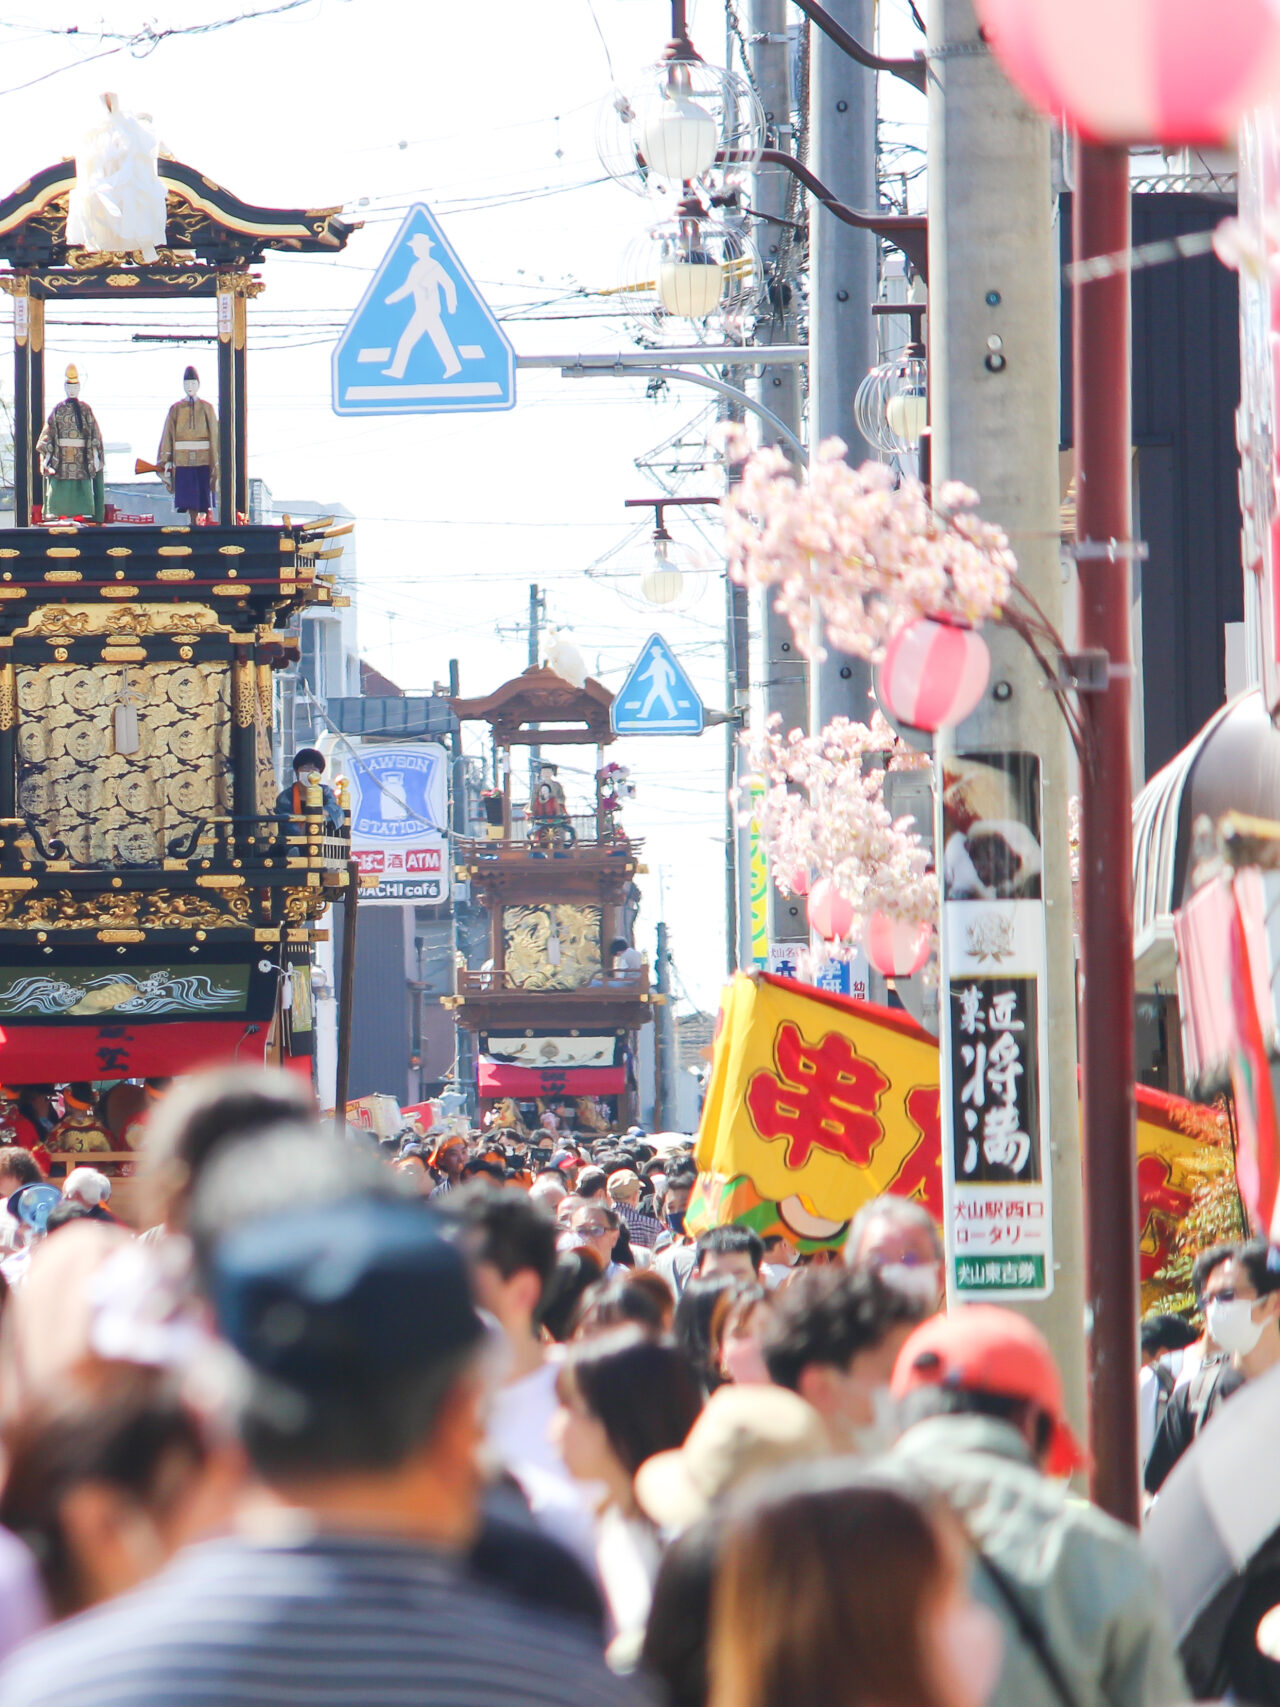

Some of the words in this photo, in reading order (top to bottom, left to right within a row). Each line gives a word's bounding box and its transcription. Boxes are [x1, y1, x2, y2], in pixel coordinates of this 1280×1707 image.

[355, 756, 430, 774] LAWSON
[358, 818, 429, 835] STATION
[387, 853, 403, 869] 酒
[406, 853, 441, 869] ATM
[404, 882, 439, 896] café
[954, 1200, 1044, 1220] 犬山駅西口
[957, 1226, 1041, 1244] ロータリー
